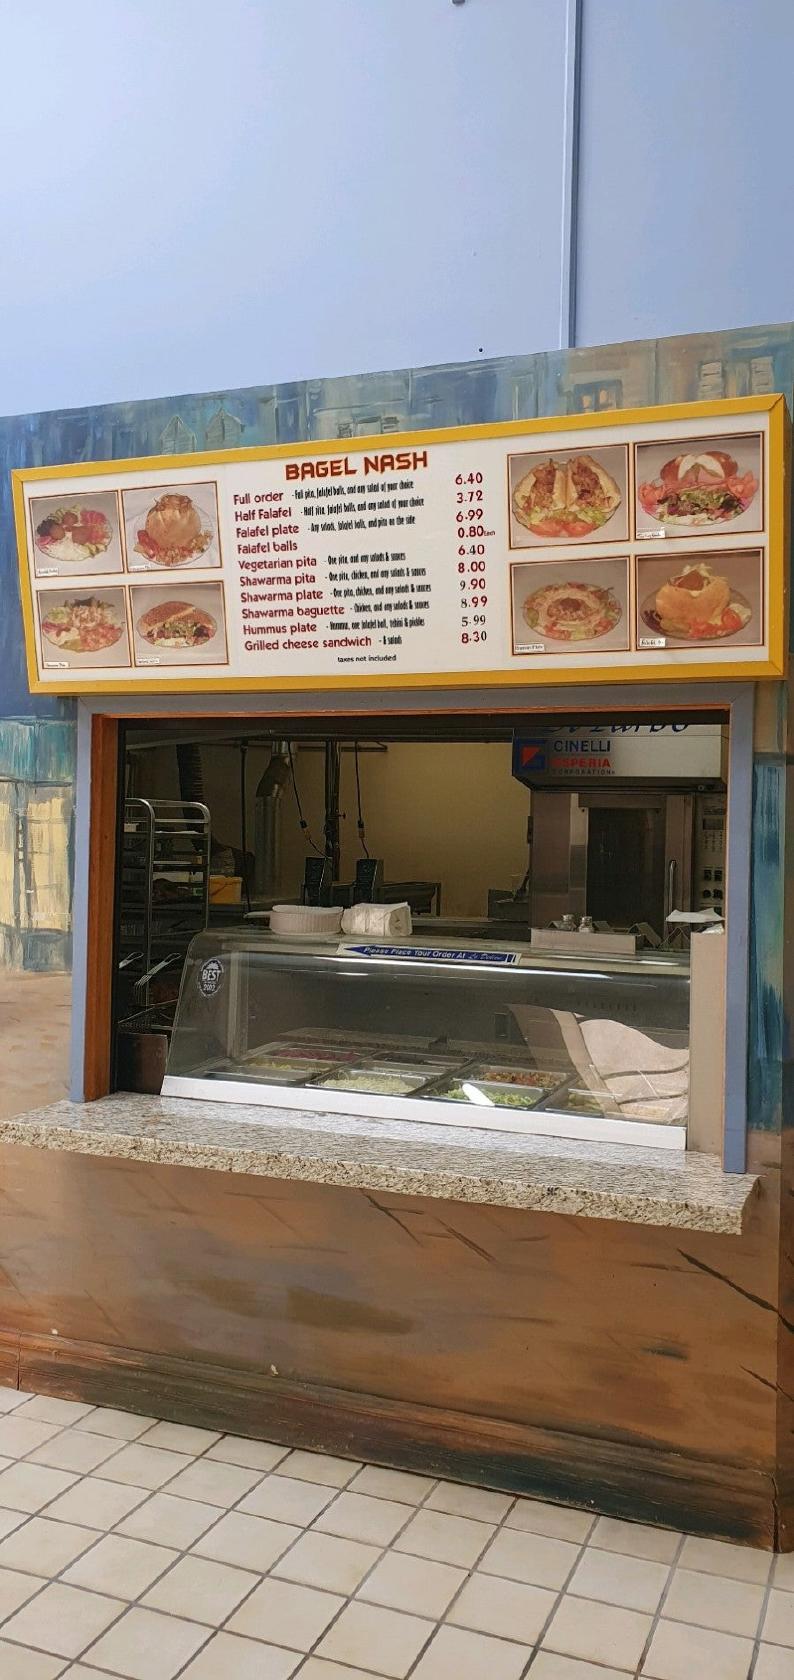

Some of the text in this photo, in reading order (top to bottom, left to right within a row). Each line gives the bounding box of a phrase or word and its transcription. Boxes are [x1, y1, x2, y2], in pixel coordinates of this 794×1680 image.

[285, 451, 428, 481] BAGEL NASH
[455, 472, 483, 485] 6.40
[233, 493, 251, 506] Full
[254, 491, 284, 503] order
[456, 490, 483, 503] 3.72
[235, 509, 256, 522] Half
[258, 507, 292, 520] Falafel
[456, 508, 483, 522] 6.99
[236, 525, 269, 538] Falafel
[272, 524, 300, 538] plate
[237, 540, 298, 554] Falafel balls
[458, 544, 485, 556] 6.40
[238, 557, 293, 572] Vegetarian
[296, 556, 317, 570] pita
[458, 561, 486, 573] 8.00
[240, 574, 292, 587] Shawarma
[295, 573, 316, 586] pita
[460, 578, 486, 591] 9.90
[241, 591, 293, 603] Shawarma
[296, 590, 323, 602] plate
[461, 595, 488, 608] 8.99
[242, 608, 294, 619] Shawarma
[297, 605, 345, 618] baguette
[461, 614, 486, 627] 5.99
[243, 624, 287, 635] Hummus
[290, 622, 317, 635] plate
[245, 640, 279, 651] Grilled
[282, 638, 318, 650] cheese
[323, 636, 371, 648] sandwich
[461, 631, 487, 644] 8.30
[554, 740, 611, 752] CINELLI
[364, 947, 389, 955] Please
[390, 948, 411, 956] Place
[202, 969, 221, 981] BEST
